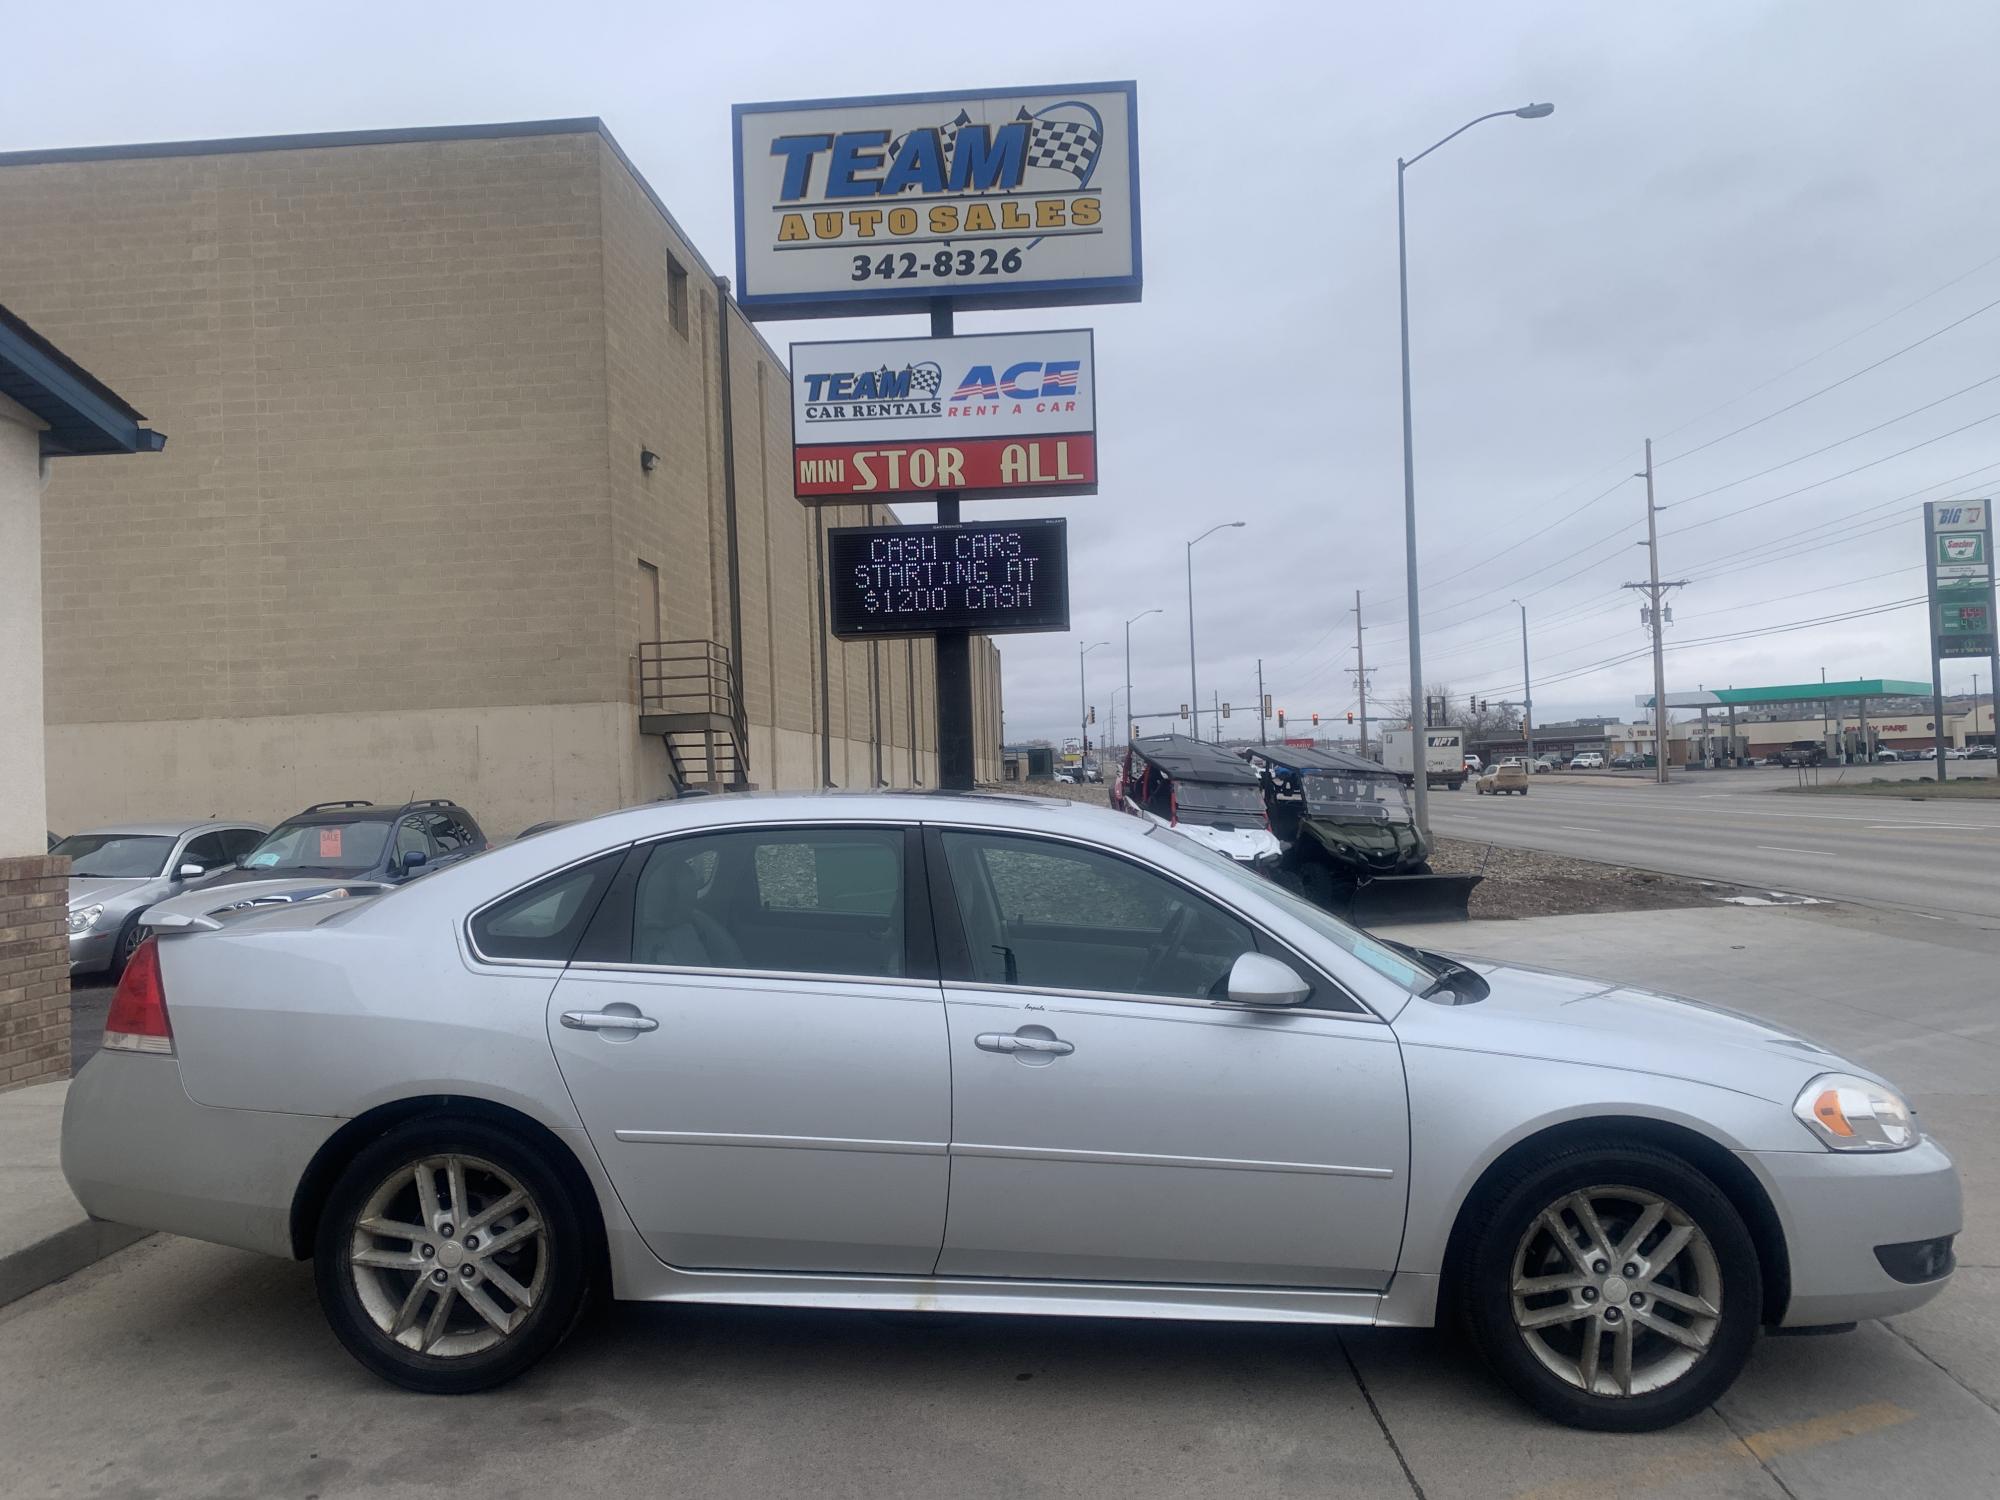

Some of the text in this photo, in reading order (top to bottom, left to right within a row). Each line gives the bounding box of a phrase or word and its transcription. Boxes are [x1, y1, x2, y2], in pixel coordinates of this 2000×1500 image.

[770, 120, 1033, 202] TEAM
[778, 197, 1102, 241] AUTO SALES
[851, 247, 1023, 282] 342-8326
[803, 369, 912, 402] TEAM
[949, 360, 1081, 402] ACE
[805, 401, 942, 420] CAR RENTALS
[947, 400, 1077, 418] RENT A CAR
[799, 458, 845, 484] MINI
[852, 440, 1085, 492] STOR ALL
[1938, 507, 1962, 525] BIG
[870, 533, 1021, 562] CASH CARS
[855, 557, 1039, 589] STARTING AT
[864, 583, 1032, 614] $1200 CASH
[1432, 737, 1455, 746] NPT
